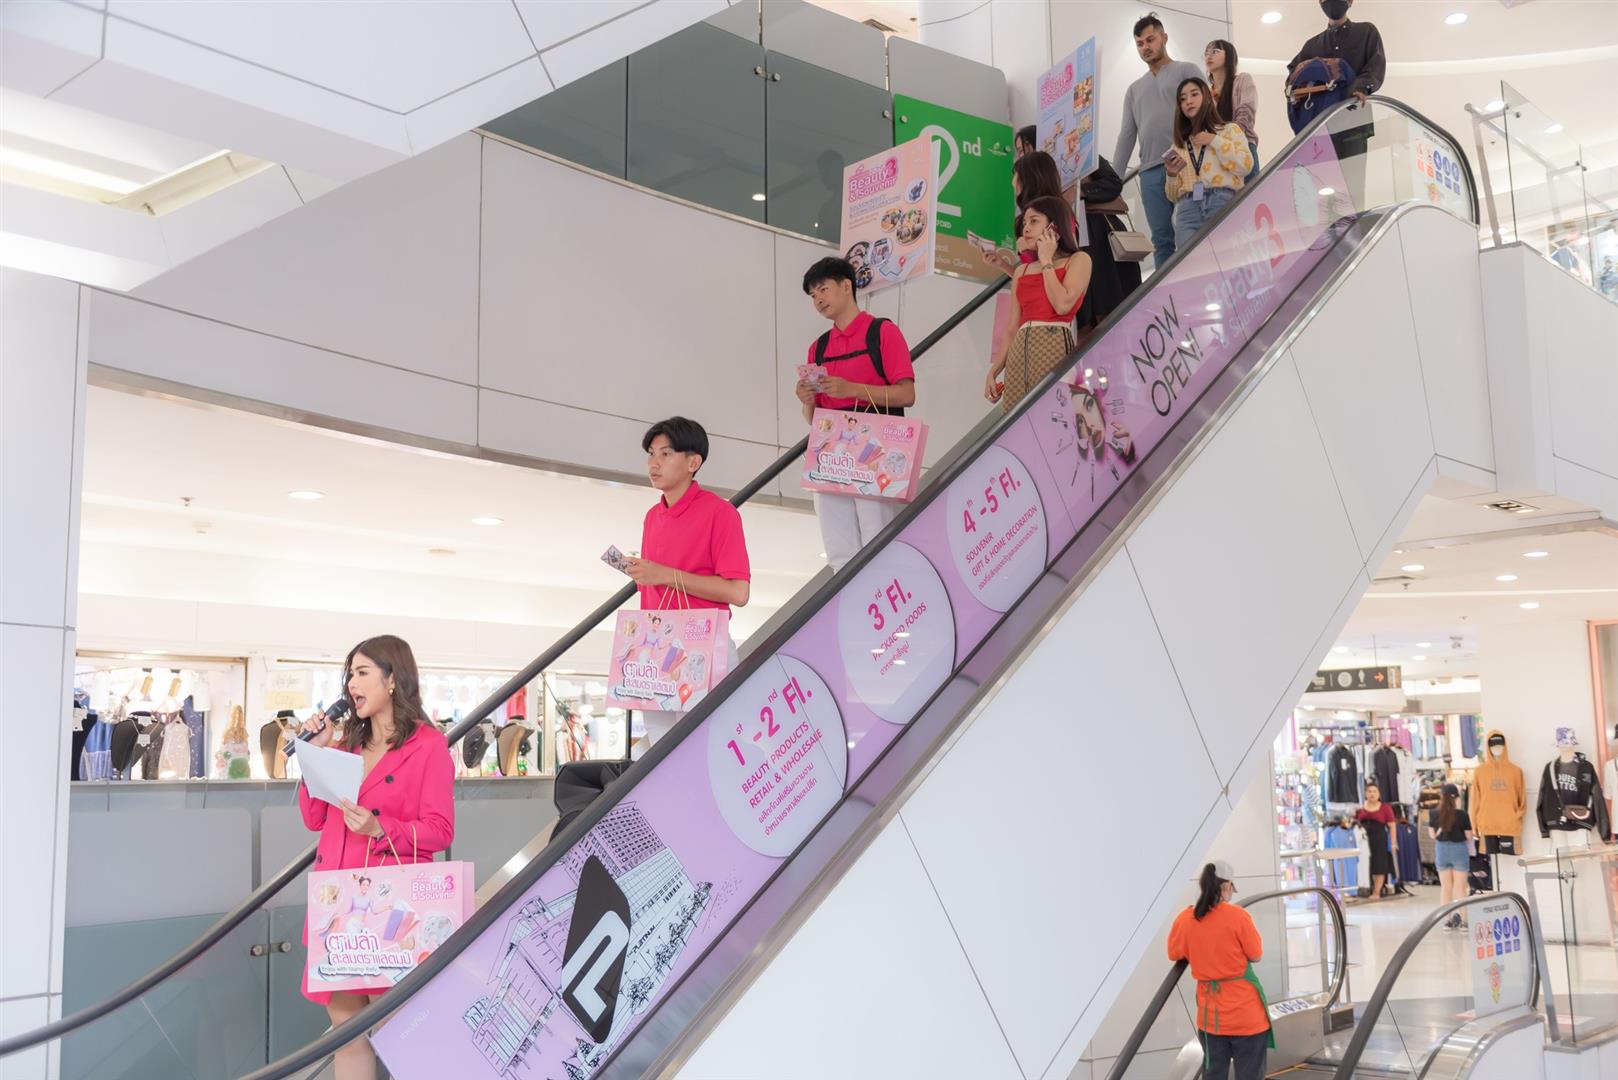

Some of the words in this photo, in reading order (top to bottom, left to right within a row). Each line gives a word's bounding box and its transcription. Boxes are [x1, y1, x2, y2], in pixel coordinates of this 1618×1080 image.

[850, 168, 889, 191] Beauty
[886, 157, 897, 178] 3
[857, 177, 897, 198] Souvenir
[1130, 293, 1181, 384] NOW
[1151, 327, 1204, 417] OPEN!
[998, 467, 1022, 499] Fl.
[965, 531, 995, 564] SOUVENIR
[971, 561, 985, 577] GIFT
[983, 554, 991, 565] &
[989, 537, 1007, 559] HOME
[1005, 504, 1038, 541] DECORATION
[885, 578, 912, 614] Fl.
[905, 602, 927, 628] FOODS
[781, 676, 813, 715] Fl.
[741, 759, 771, 794] BEAUTY
[770, 721, 810, 765] PRODUCTS
[749, 781, 776, 808] RETAIL
[774, 772, 783, 784] &
[780, 728, 823, 775] WHOLESALE
[412, 880, 448, 893] Beauty
[444, 874, 455, 890] 3
